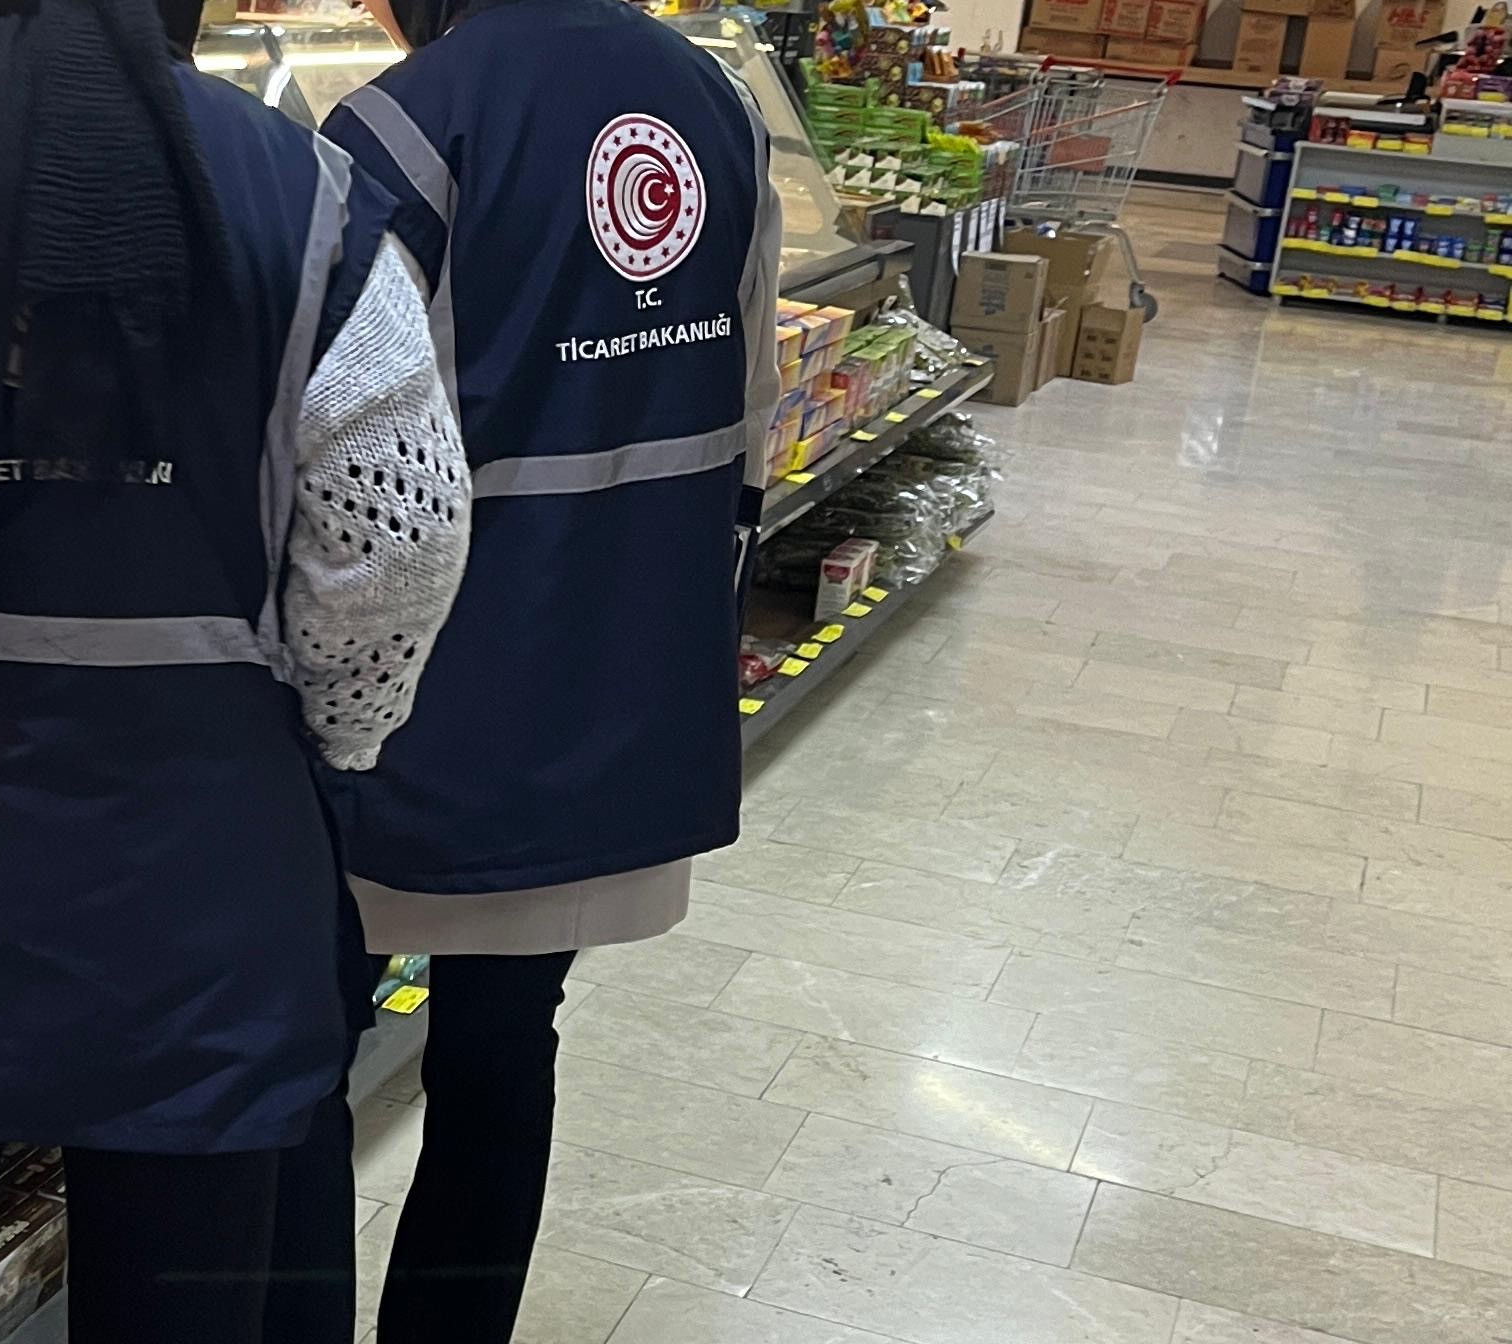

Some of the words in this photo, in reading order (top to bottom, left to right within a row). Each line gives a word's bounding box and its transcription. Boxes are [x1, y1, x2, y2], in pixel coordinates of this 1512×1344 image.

[635, 287, 662, 309] T.C.
[555, 333, 638, 362] TİCARET
[639, 313, 732, 350] BAKANLIĞI
